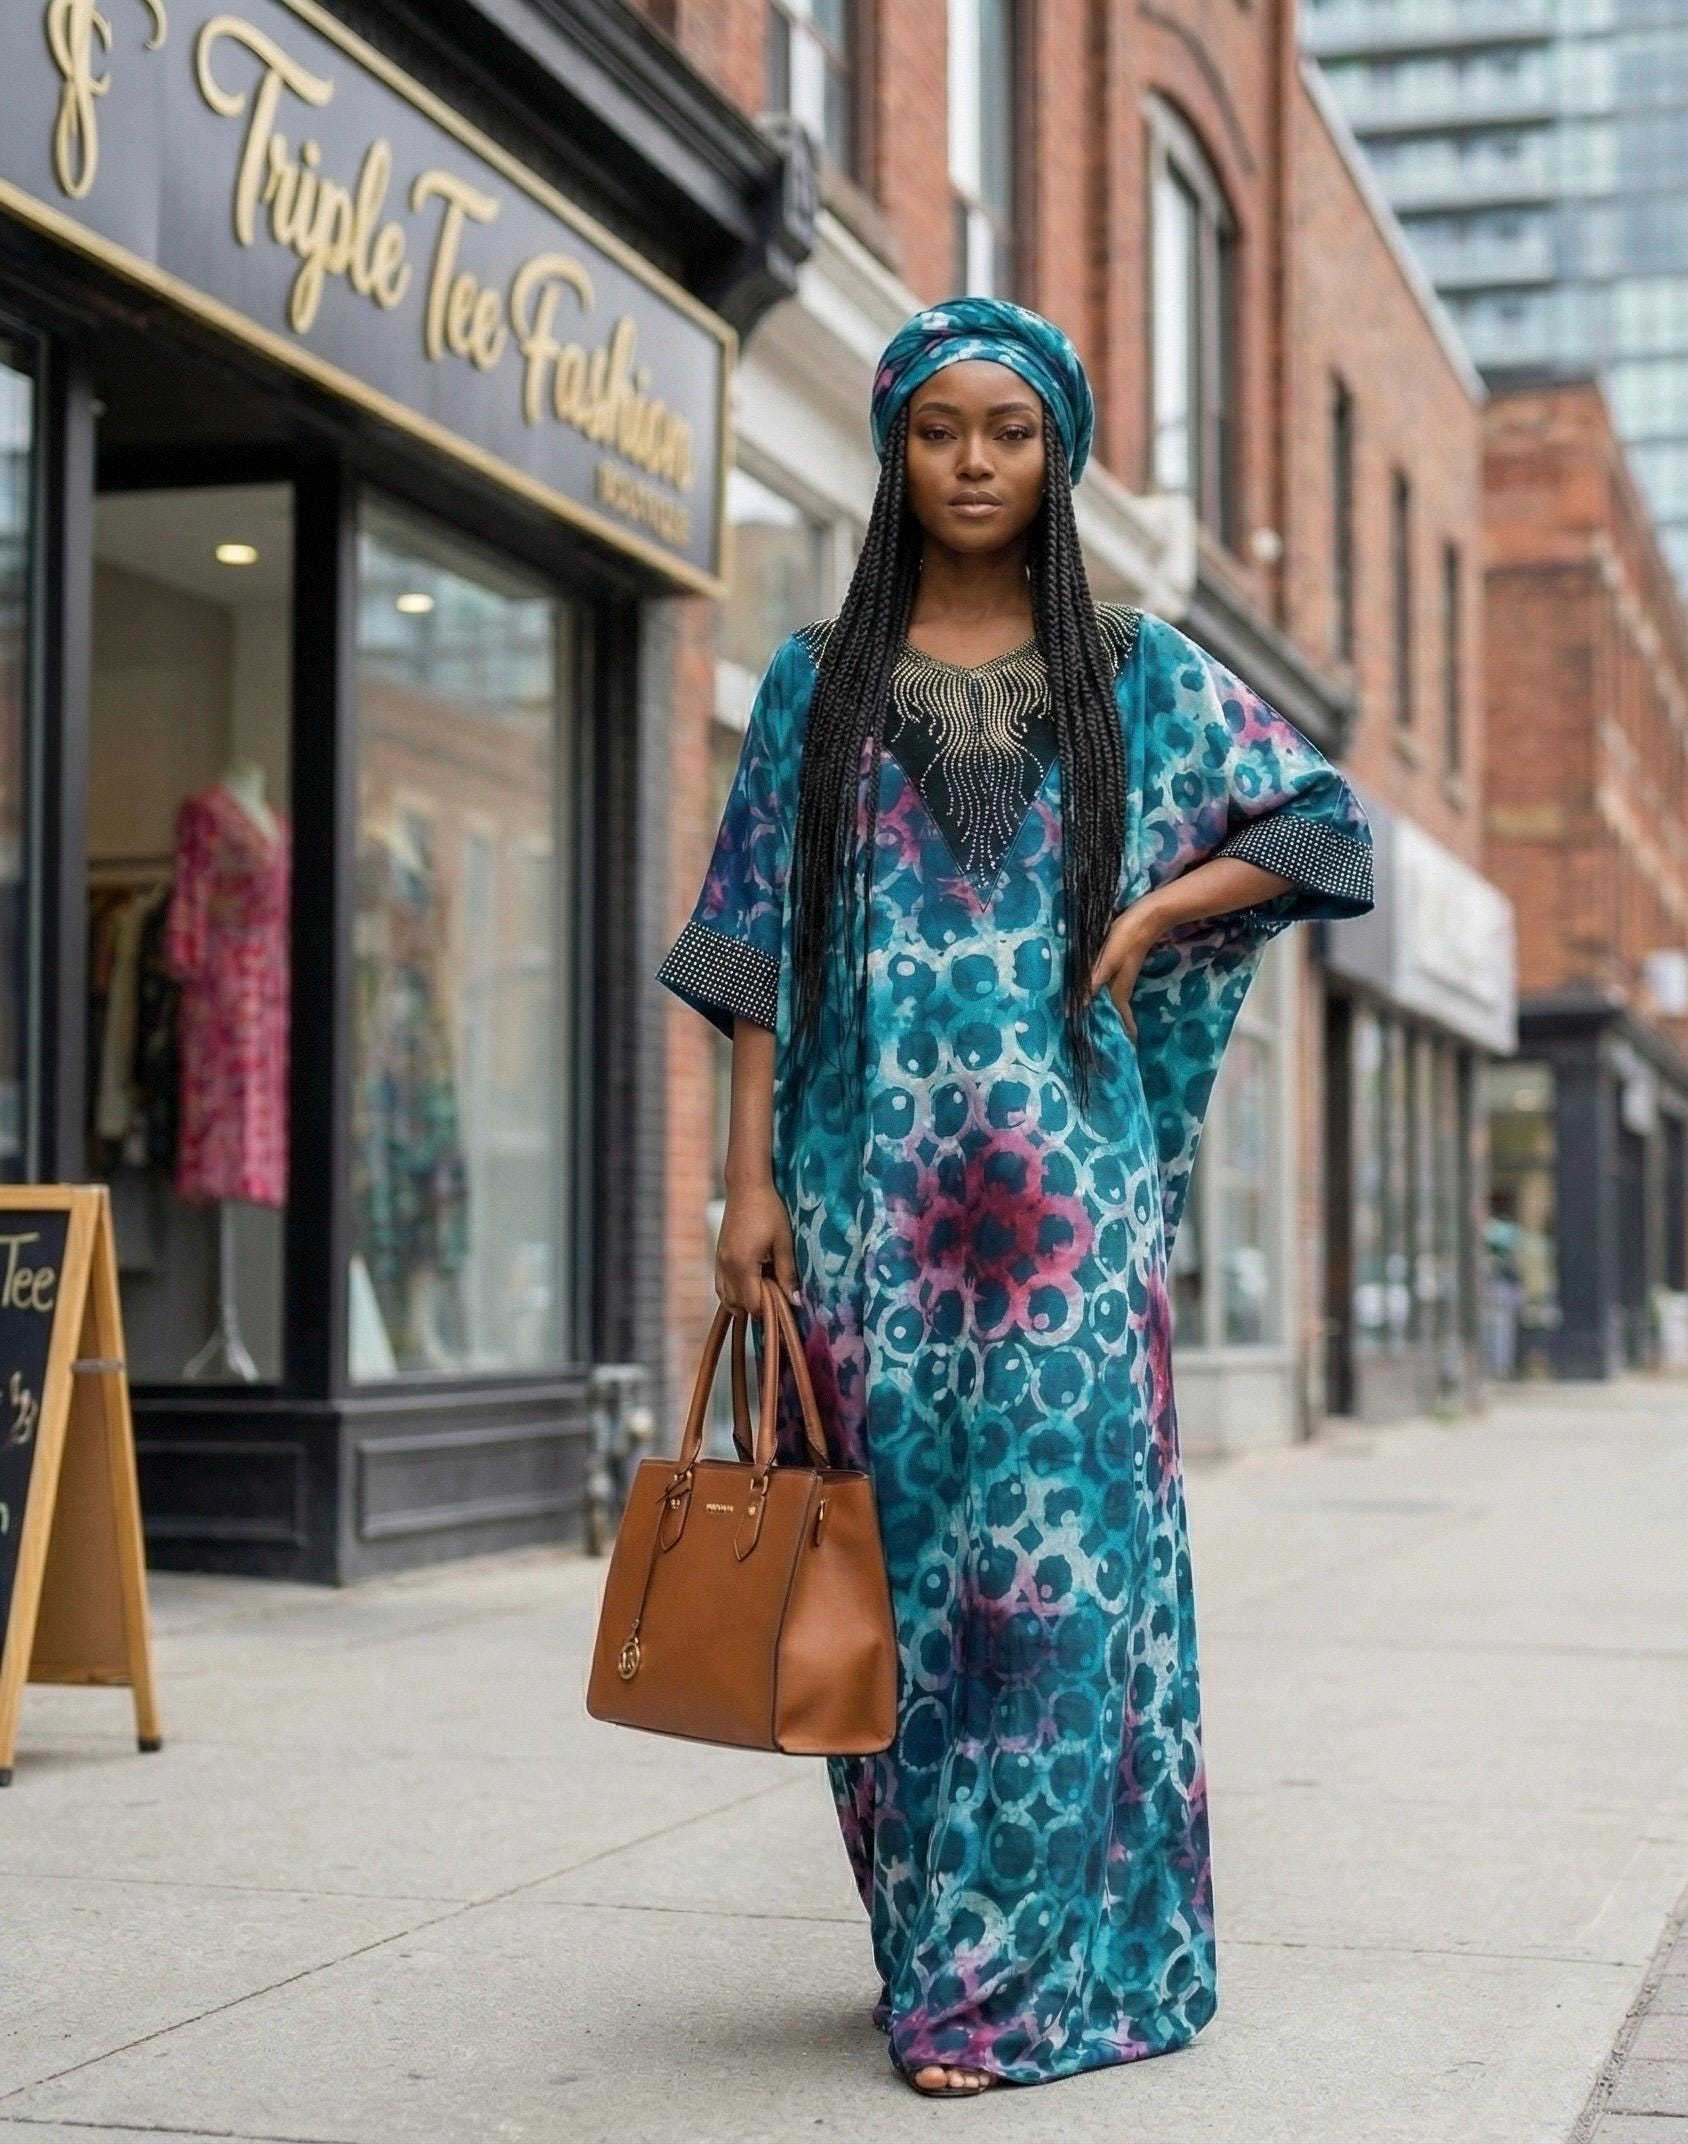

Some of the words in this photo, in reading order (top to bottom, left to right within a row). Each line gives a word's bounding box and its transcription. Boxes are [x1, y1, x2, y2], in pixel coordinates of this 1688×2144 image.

[196, 14, 412, 335] Triple
[412, 170, 509, 370] Tee
[511, 253, 694, 494] Fashion
[0, 1231, 56, 1312] Tee
